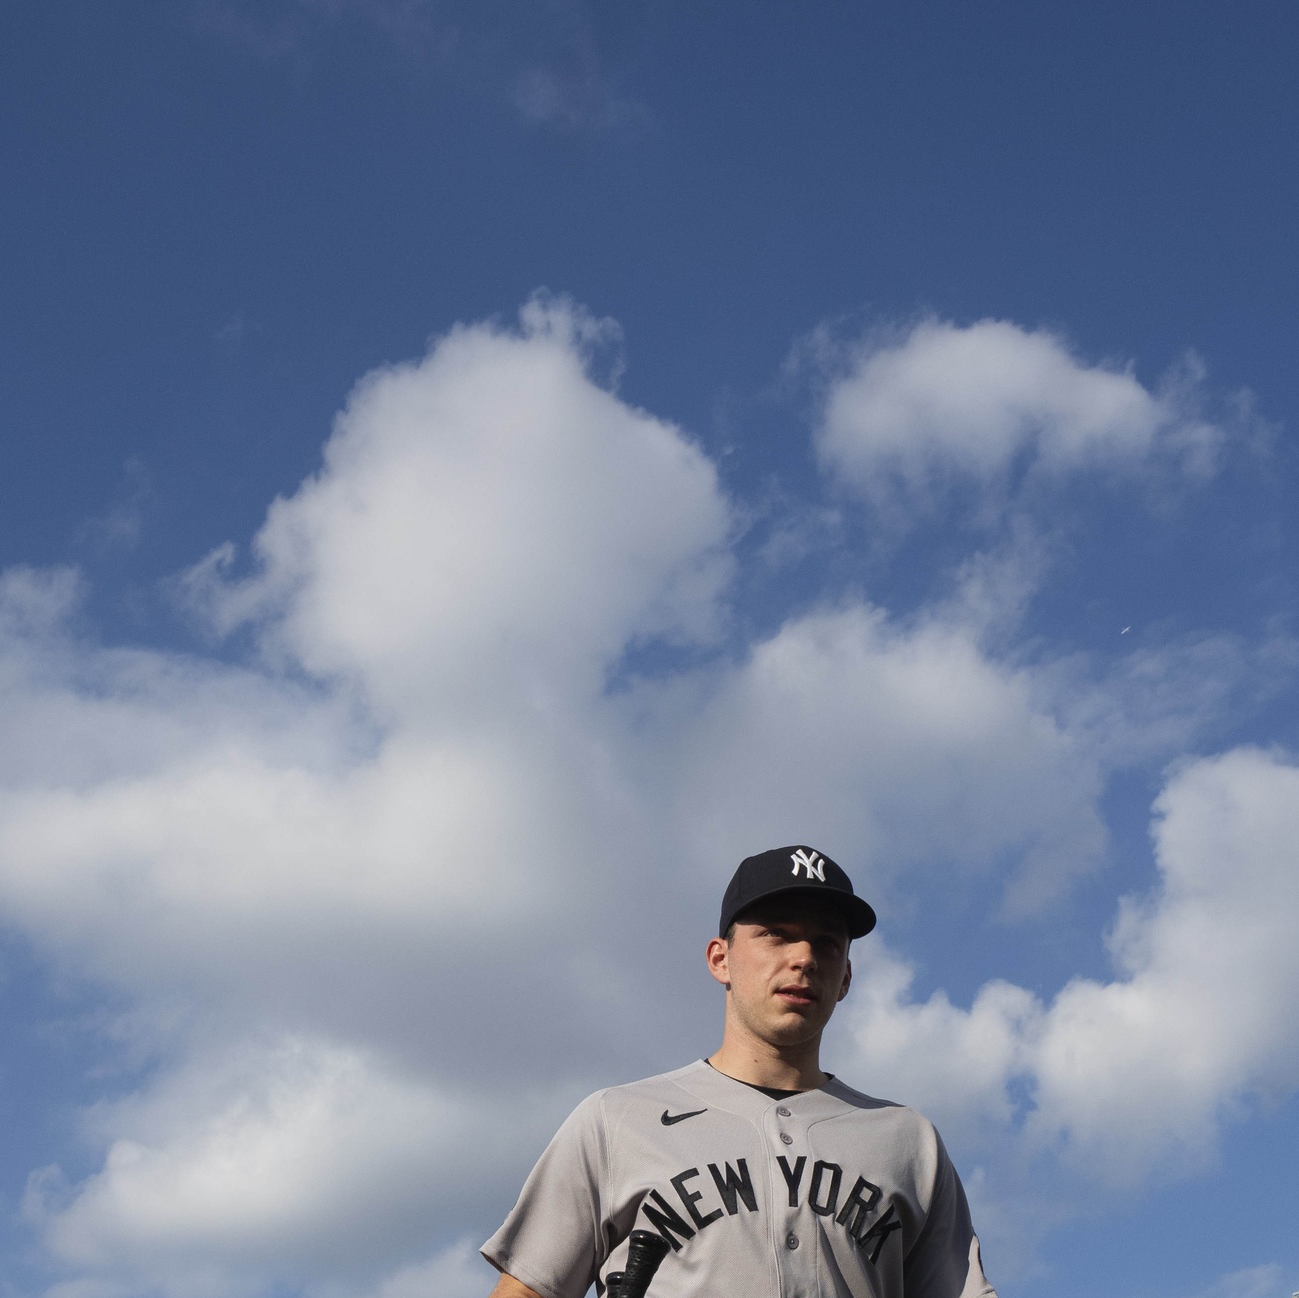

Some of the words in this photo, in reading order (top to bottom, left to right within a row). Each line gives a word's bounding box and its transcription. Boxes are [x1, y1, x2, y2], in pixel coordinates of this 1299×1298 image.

[790, 849, 827, 882] NY
[641, 1158, 759, 1253] NEW
[776, 1155, 903, 1266] YORK
